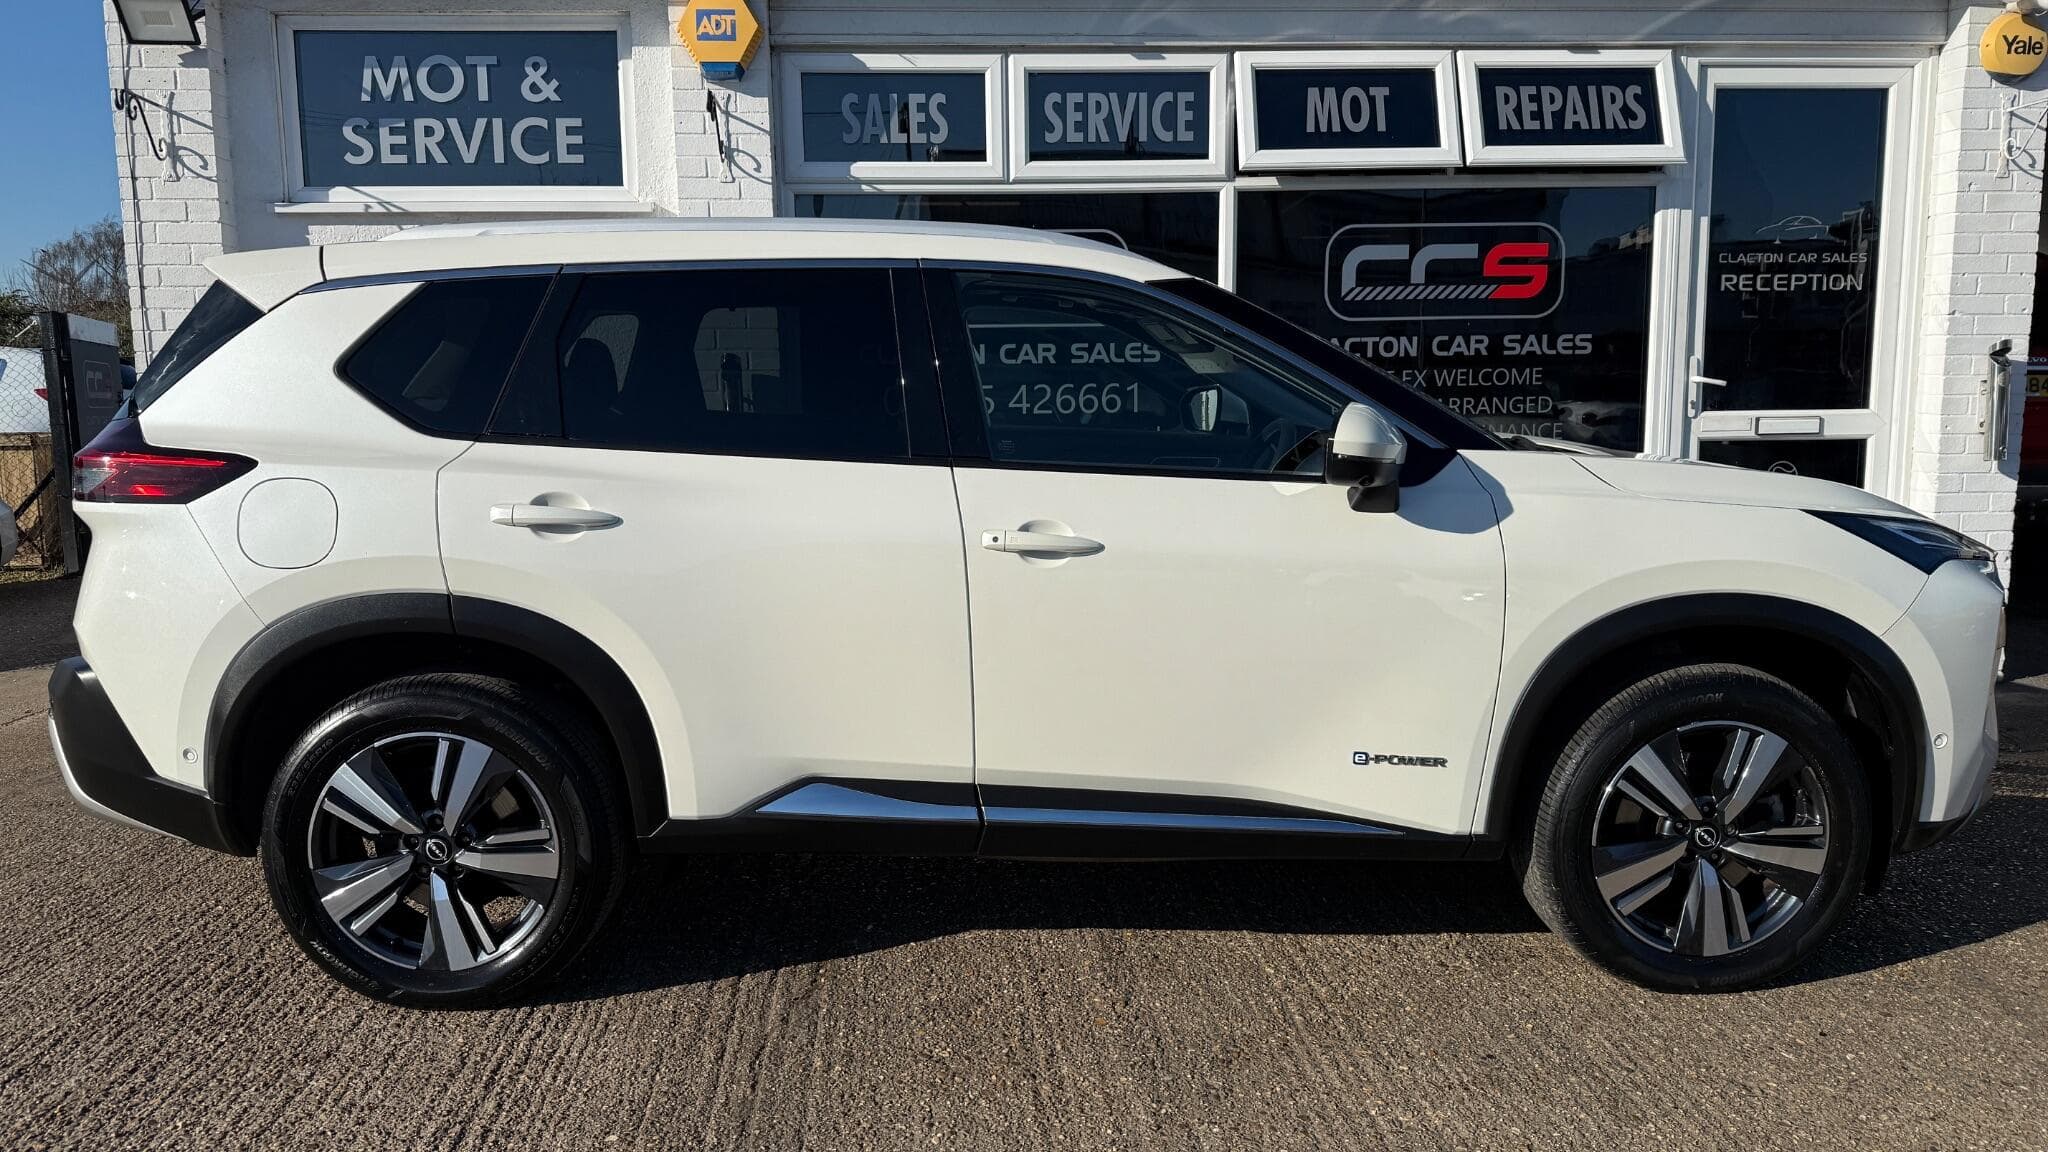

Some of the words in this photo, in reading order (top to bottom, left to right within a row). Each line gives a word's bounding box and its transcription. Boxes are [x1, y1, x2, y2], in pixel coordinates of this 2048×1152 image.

[697, 14, 737, 36] ADT
[2002, 34, 2044, 55] Yale
[361, 54, 498, 103] MOT
[520, 55, 562, 103] &
[841, 92, 949, 145] SALES
[1044, 91, 1195, 144] SERVICE
[1306, 86, 1390, 133] MOT
[1495, 85, 1647, 130] REPAIRS
[342, 116, 585, 165] SERVICE
[1719, 252, 1784, 264] CLACTON
[1788, 252, 1817, 264] CAR
[1822, 252, 1868, 264] SALES
[1341, 241, 1551, 301] CCS
[1720, 273, 1864, 292] RECEPTION
[1000, 343, 1057, 365] CAR
[1070, 342, 1161, 364] SALES
[1330, 335, 1418, 358] CTON
[1432, 335, 1489, 357] CAR
[1503, 333, 1593, 356] SALES
[1434, 367, 1543, 388] WELCOME
[1008, 382, 1140, 415] 426661
[1438, 396, 1554, 416] RRANGED
[1352, 751, 1448, 768] e-POWER
